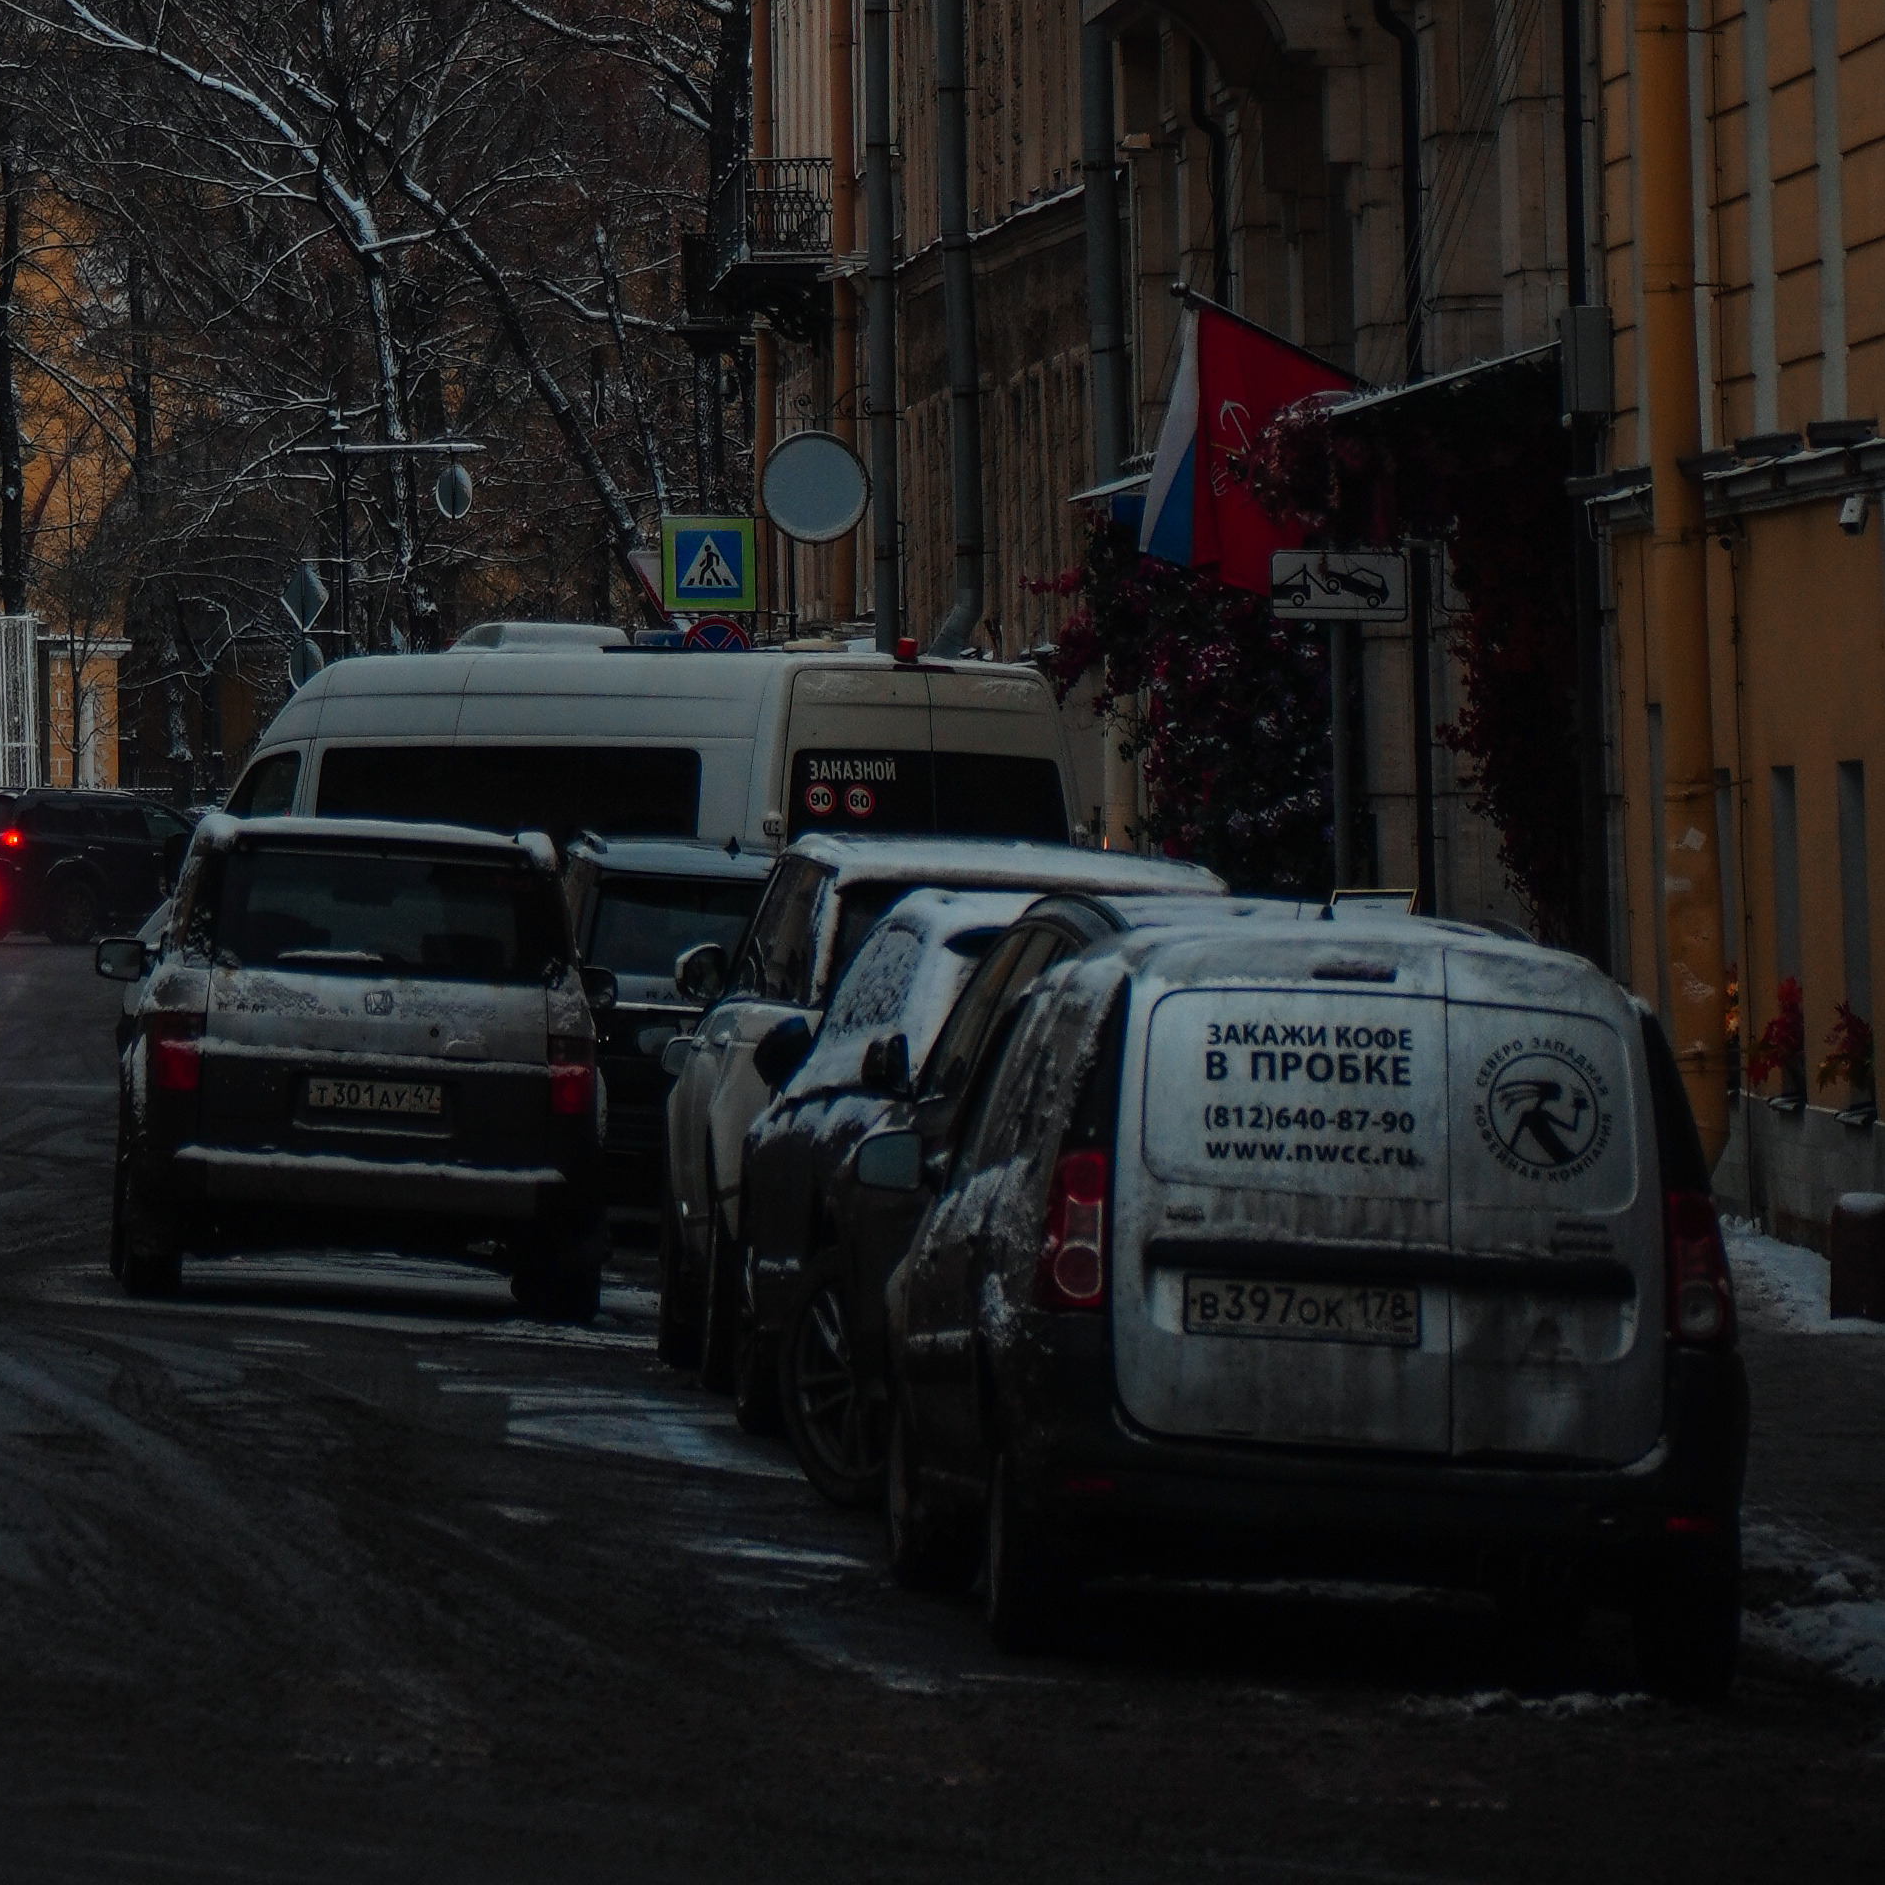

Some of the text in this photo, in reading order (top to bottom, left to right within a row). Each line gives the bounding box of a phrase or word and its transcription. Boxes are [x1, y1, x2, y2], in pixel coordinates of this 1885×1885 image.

[808, 757, 897, 781] ЗАКАЗНОЙ
[810, 792, 870, 808] 90 60
[1206, 1023, 1413, 1050] ЗАКАЖИ КОФЕ
[1206, 1051, 1412, 1086] В ПРОБКЕ
[1476, 1037, 1609, 1096] СЕВЕРО ЗАПАДНАЯ
[316, 1082, 434, 1108] Т301АУ 47
[1204, 1104, 1415, 1133] (812)640-87-90
[1206, 1141, 1414, 1166] www.nwcc.ru
[1474, 1103, 1613, 1182] КОФЕЙНАЯ КОМПАНИЯ
[1199, 1284, 1408, 1327] В397ОК 178
